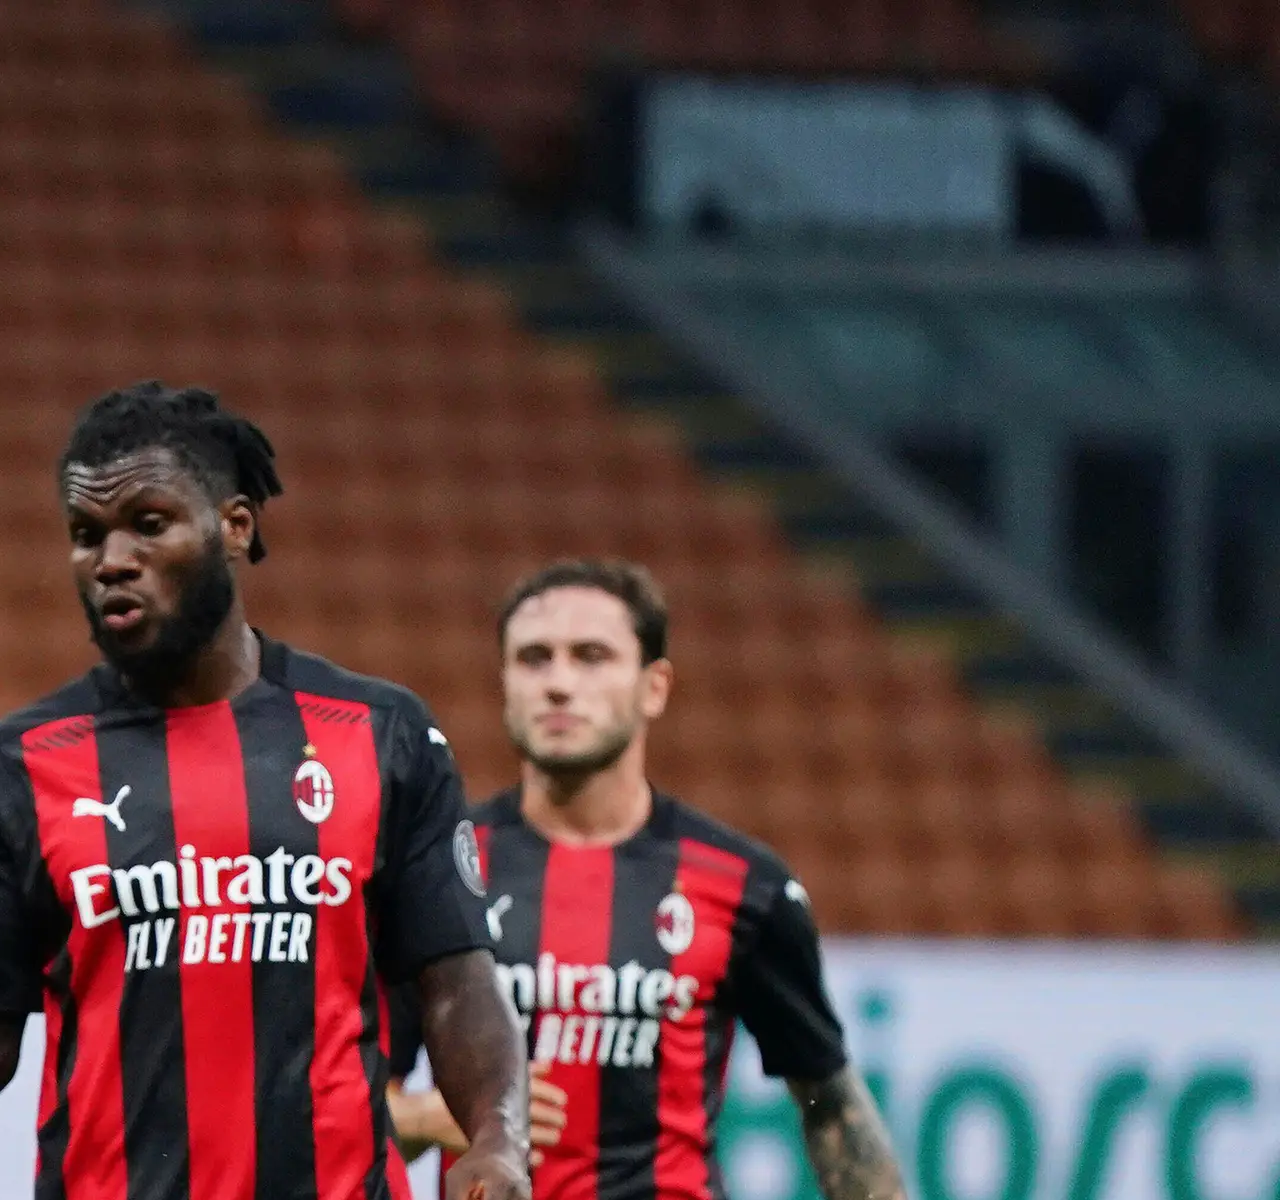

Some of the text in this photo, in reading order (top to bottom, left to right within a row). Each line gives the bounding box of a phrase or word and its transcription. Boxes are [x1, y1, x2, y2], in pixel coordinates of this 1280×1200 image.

[71, 844, 353, 929] Emirates
[124, 912, 312, 972] FLY BETTER
[494, 952, 700, 1023] mirates
